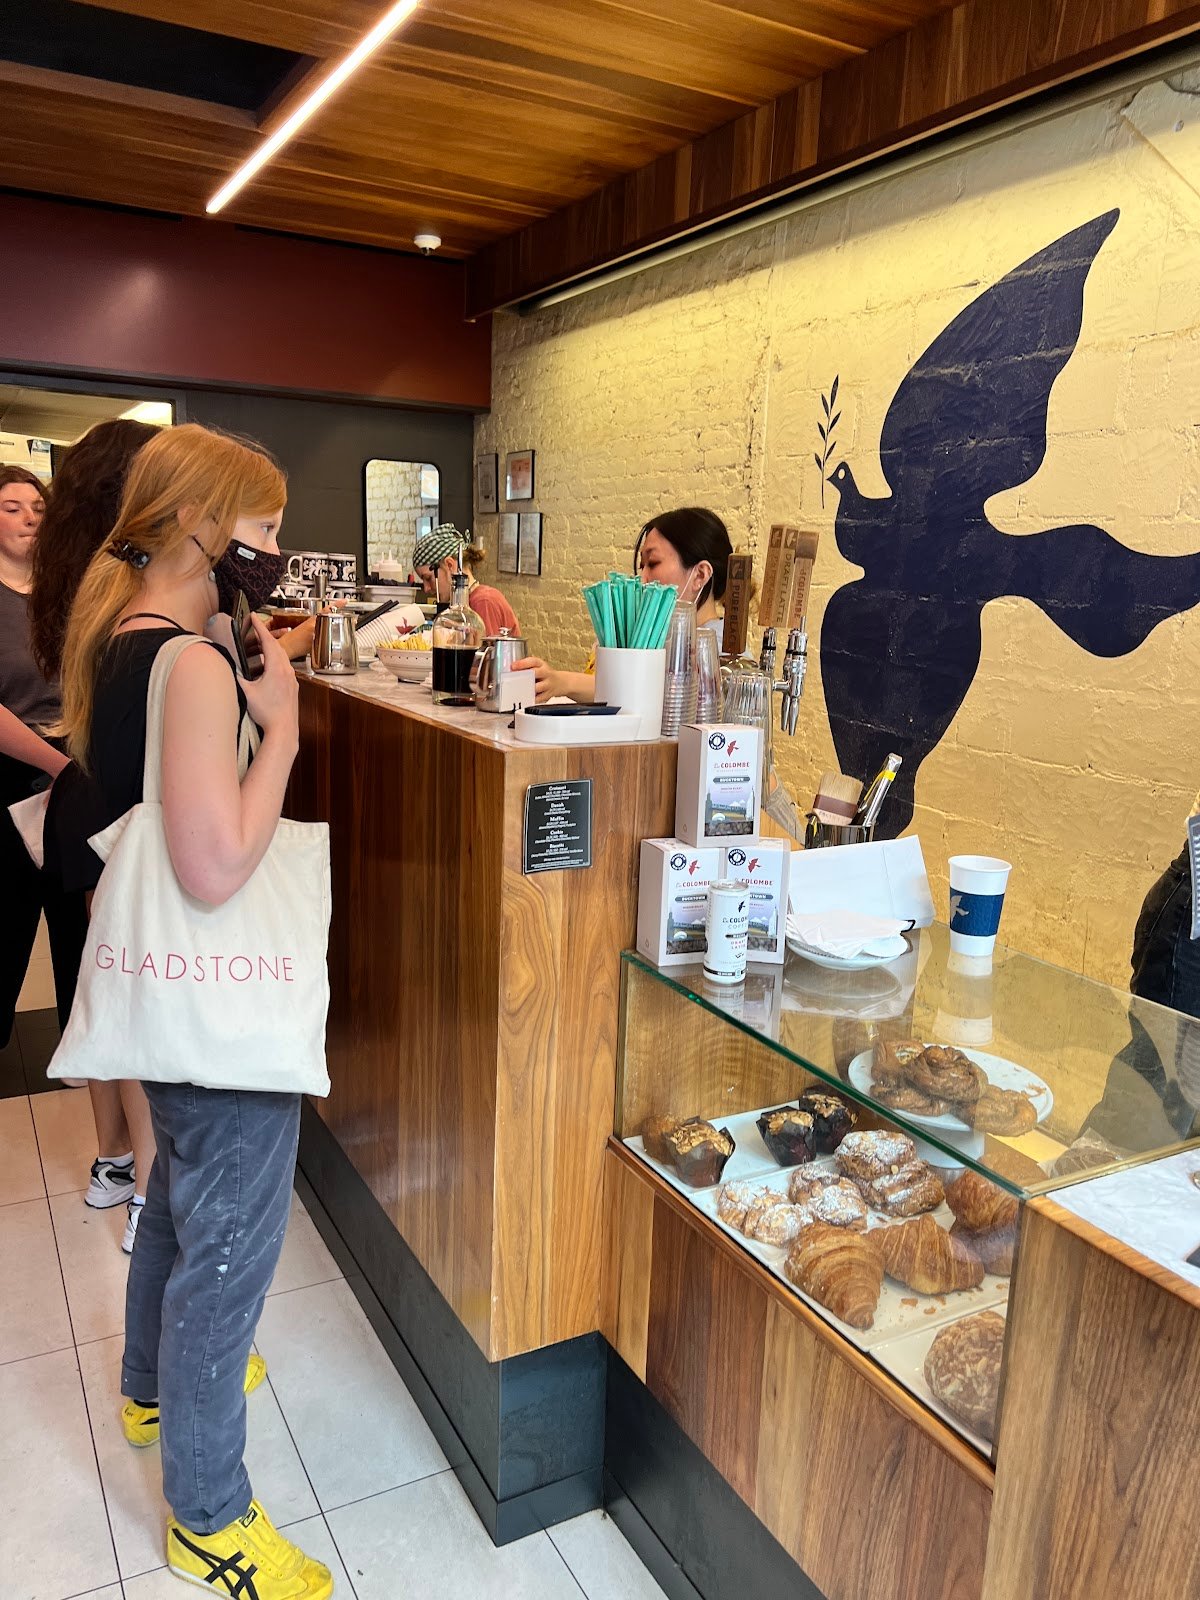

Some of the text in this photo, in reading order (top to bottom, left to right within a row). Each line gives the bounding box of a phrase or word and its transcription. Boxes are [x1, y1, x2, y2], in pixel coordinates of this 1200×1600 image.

[777, 553, 792, 623] DRAFT LATTE
[95, 943, 294, 982] GLADSTONE
